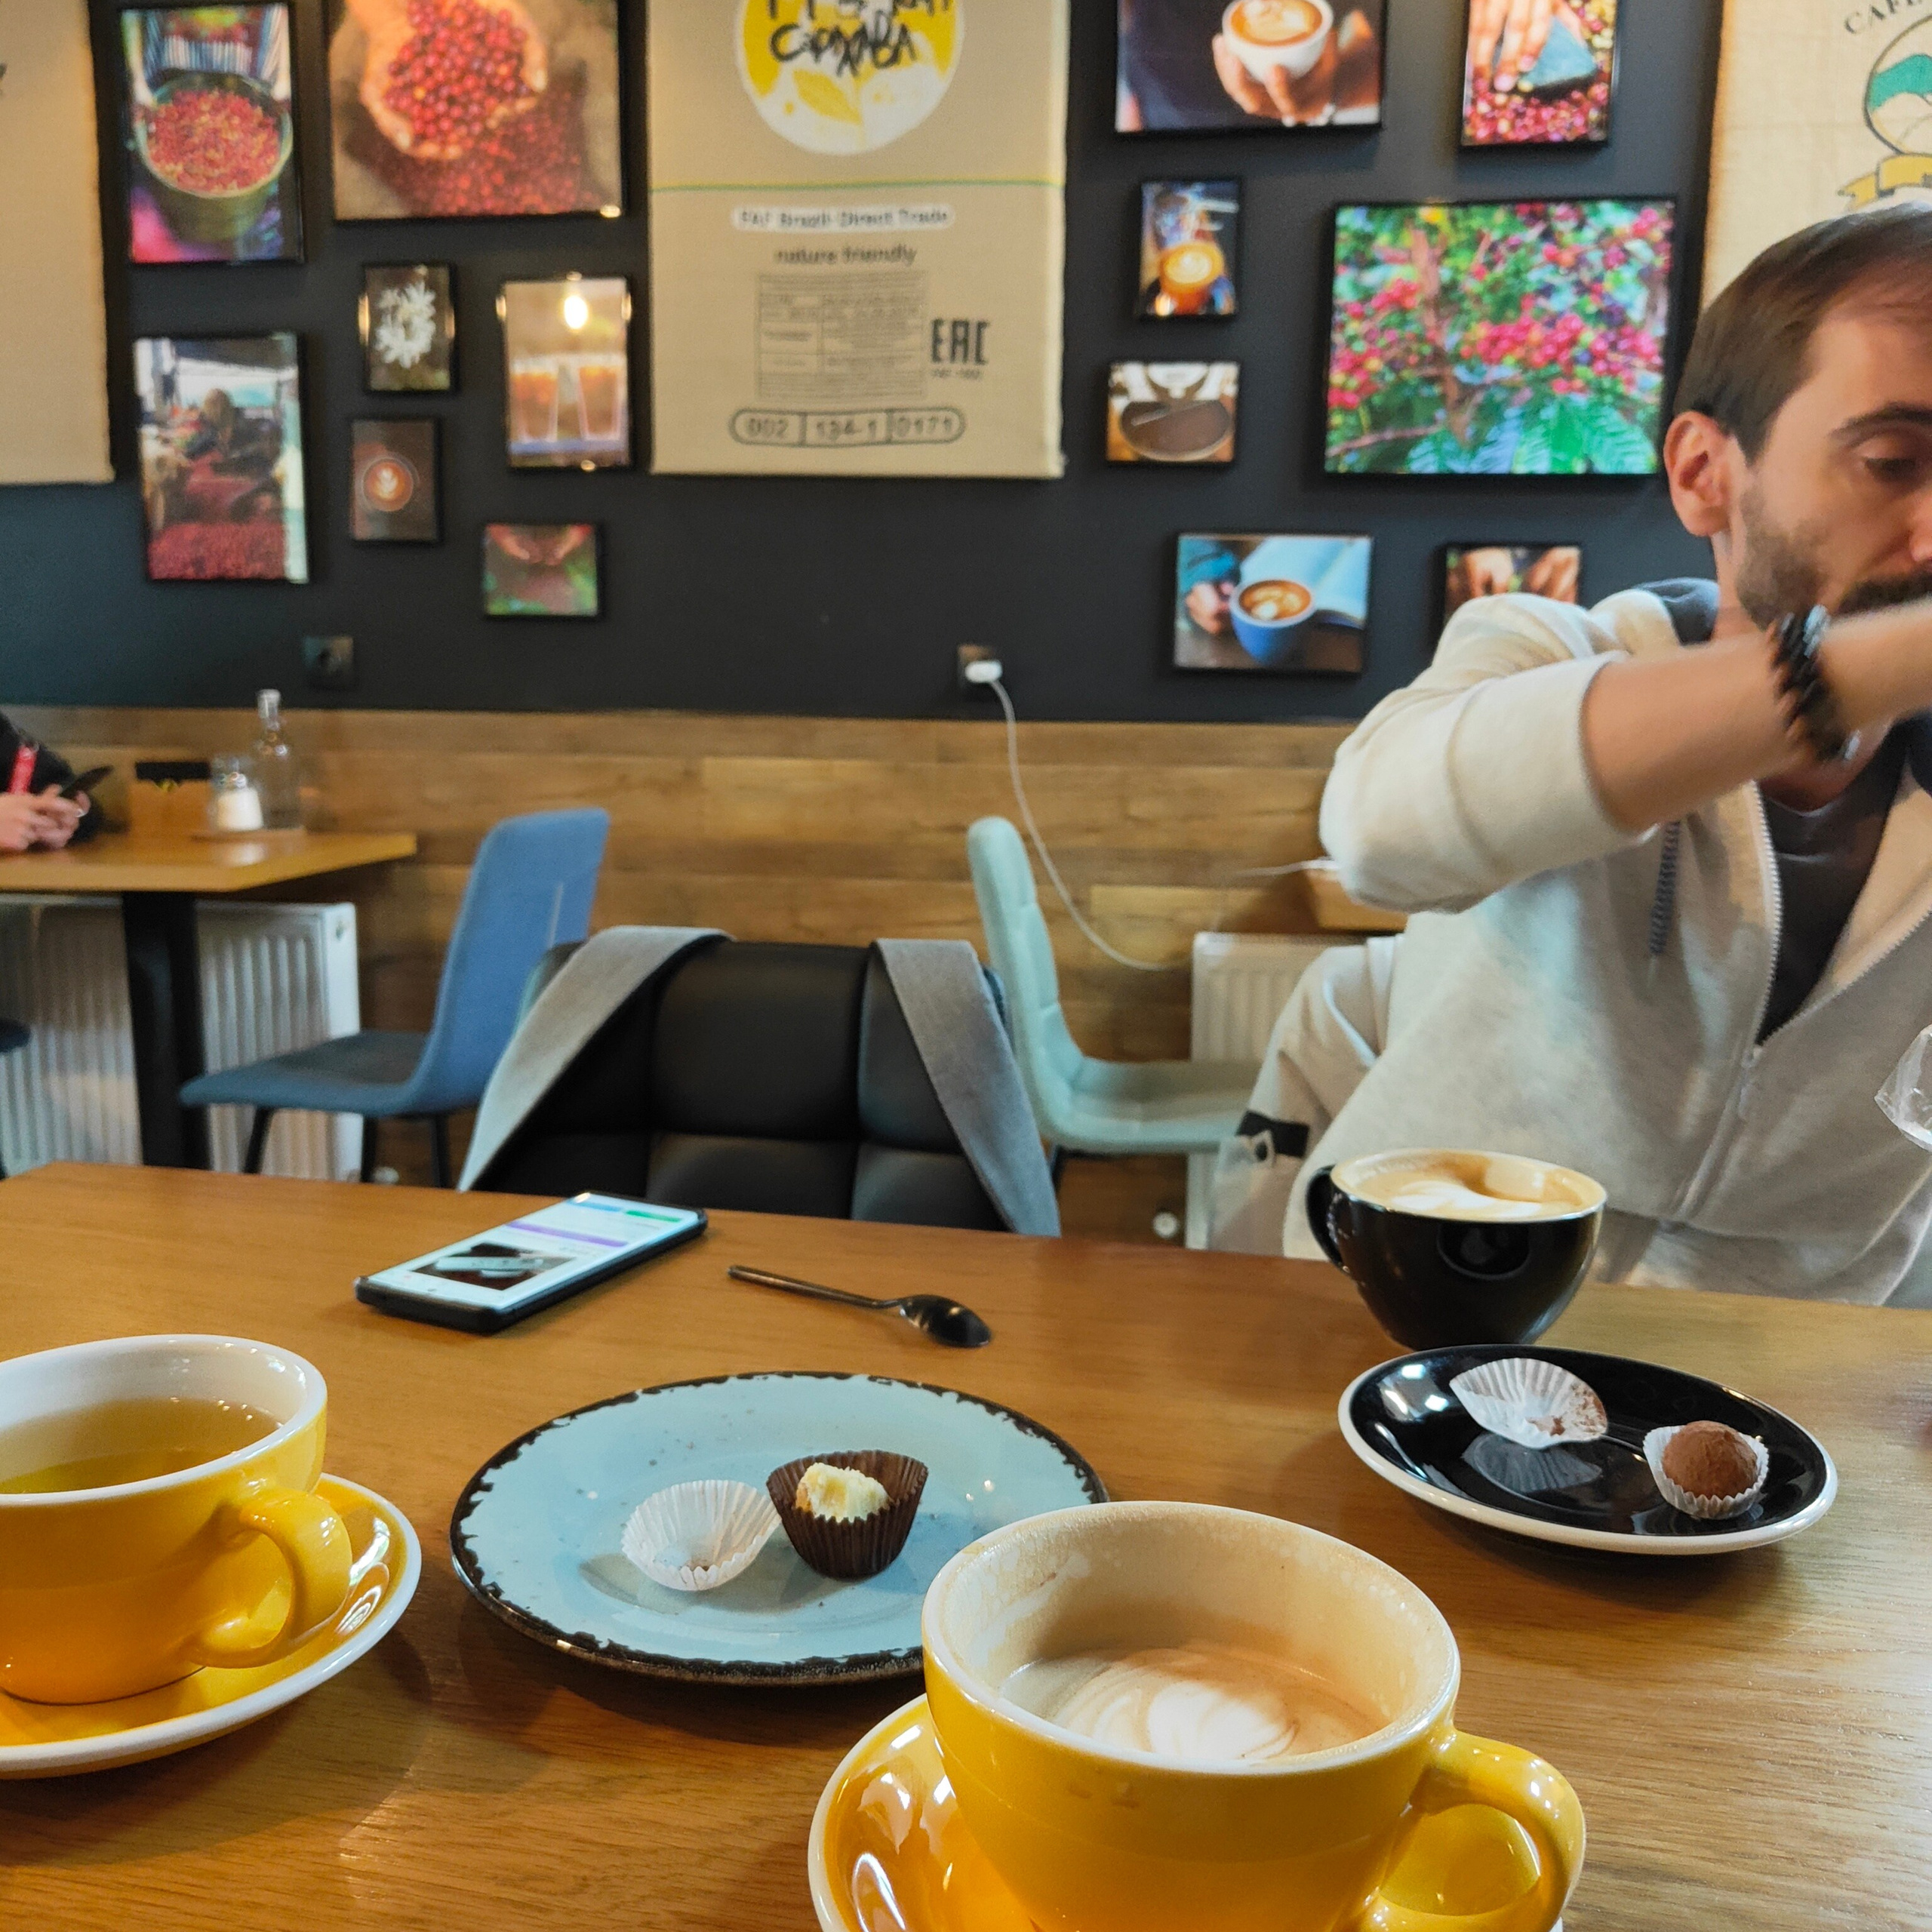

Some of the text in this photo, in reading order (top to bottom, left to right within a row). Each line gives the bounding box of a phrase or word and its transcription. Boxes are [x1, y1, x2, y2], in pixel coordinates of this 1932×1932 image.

[839, 210, 893, 226] Direct
[898, 208, 947, 224] Trade
[776, 243, 917, 266] nature friendly
[931, 318, 989, 365] EAC
